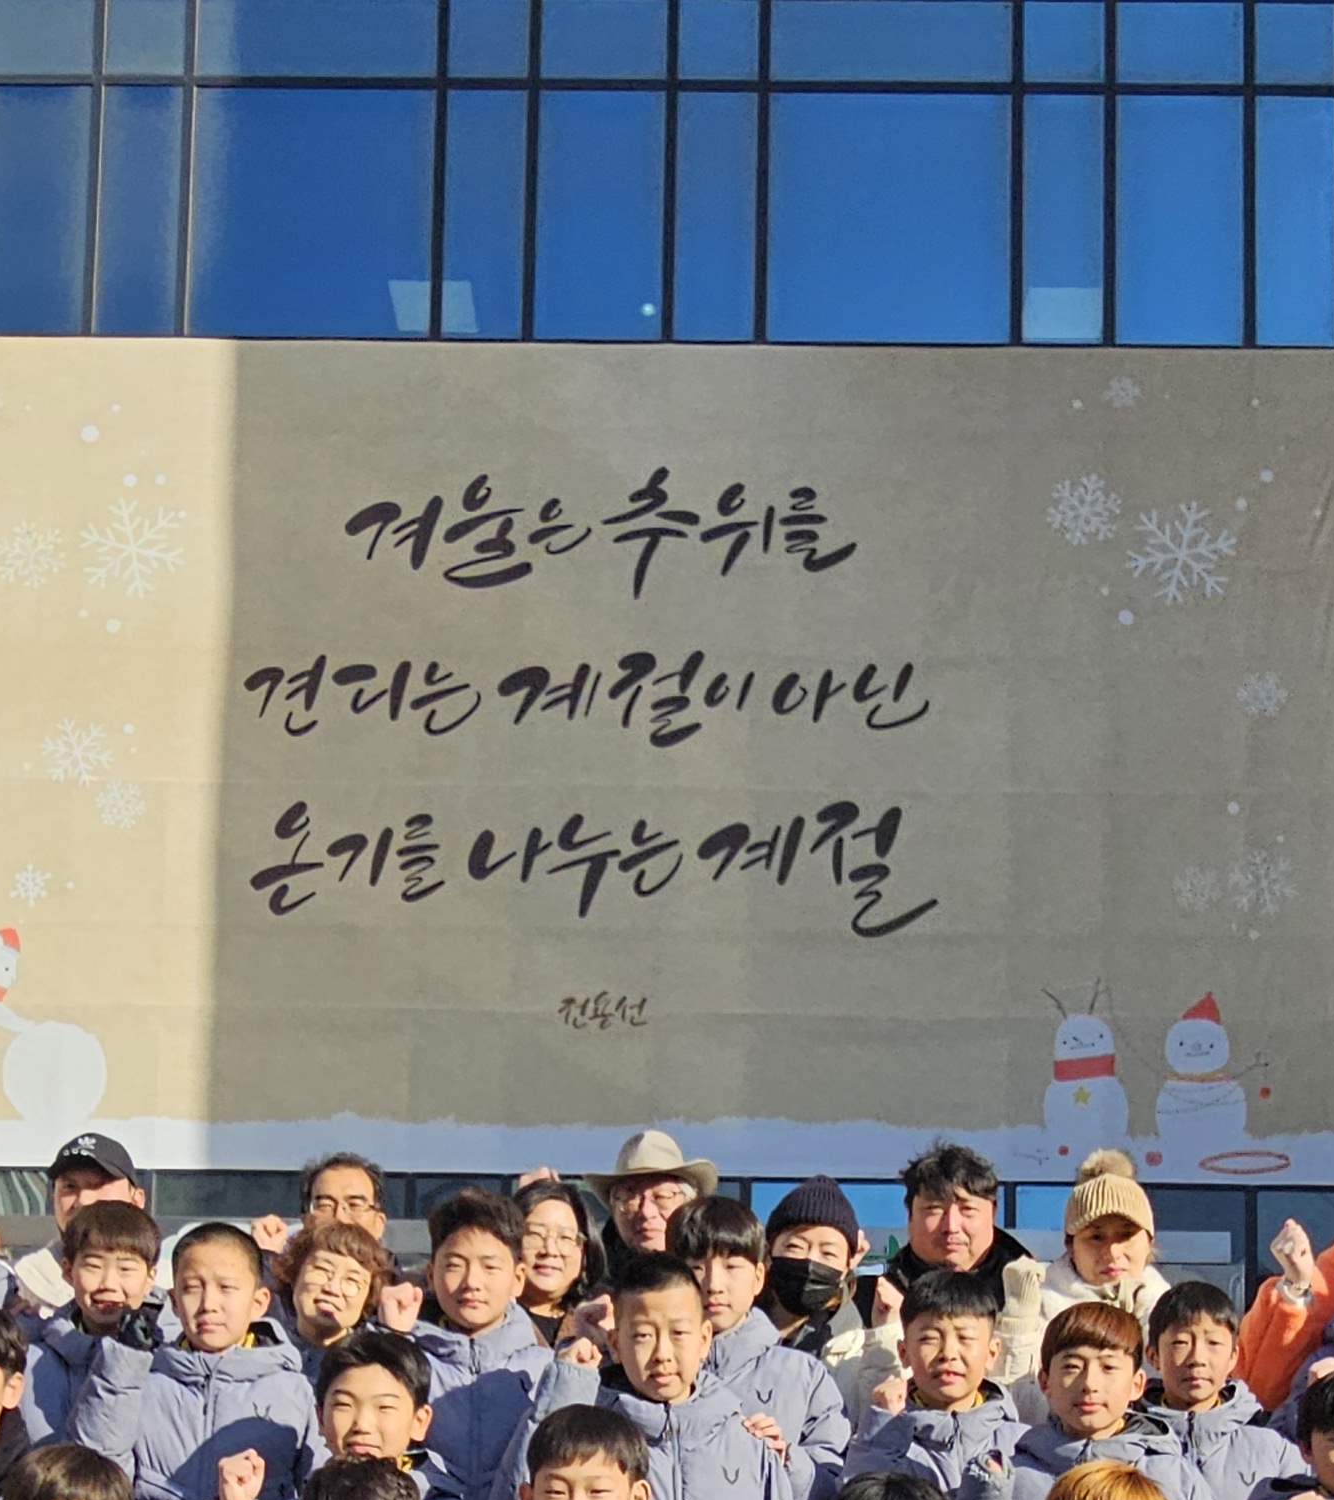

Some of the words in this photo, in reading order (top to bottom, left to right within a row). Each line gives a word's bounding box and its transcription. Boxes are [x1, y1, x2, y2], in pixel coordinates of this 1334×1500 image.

[345, 474, 592, 588] 겨울은
[602, 467, 857, 599] 추위를
[244, 655, 481, 736] 견디는
[498, 651, 755, 747] 계절이
[772, 663, 929, 730] 아닌
[250, 802, 445, 915] 온기를
[468, 814, 683, 917] 나누는
[697, 801, 938, 938] 계절
